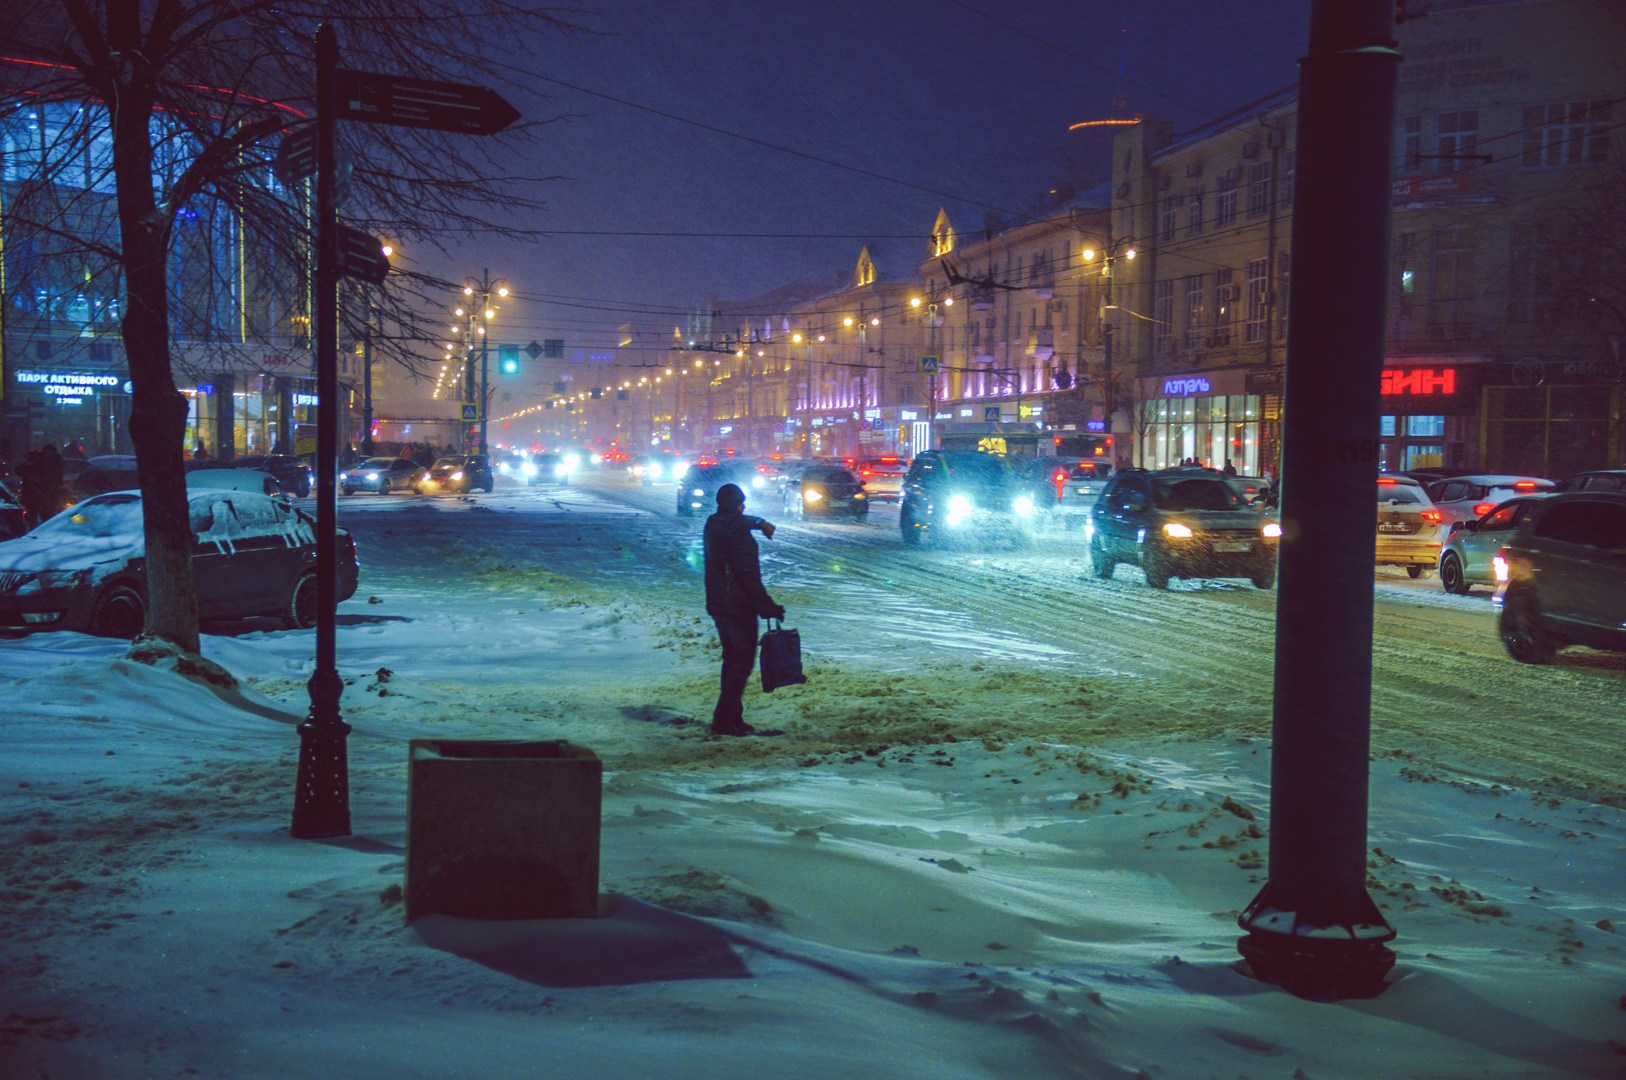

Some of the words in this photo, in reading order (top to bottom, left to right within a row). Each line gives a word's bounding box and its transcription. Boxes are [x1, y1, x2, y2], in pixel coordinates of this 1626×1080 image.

[17, 373, 49, 383] ПАРК
[50, 374, 118, 386] АКТИВНОГО
[43, 384, 94, 396] ОТДЫХА
